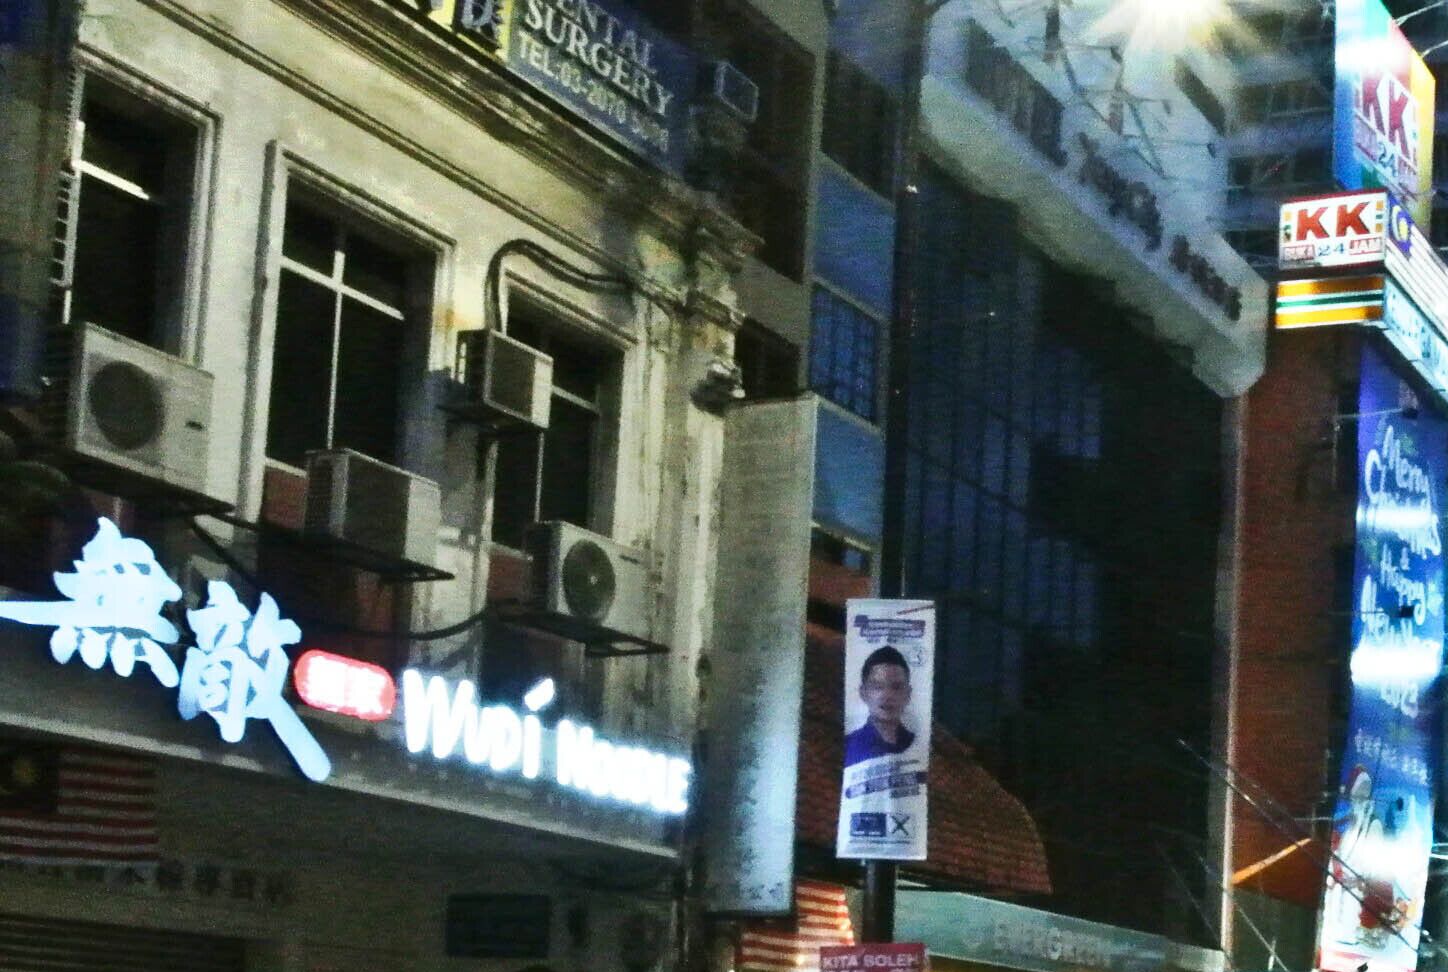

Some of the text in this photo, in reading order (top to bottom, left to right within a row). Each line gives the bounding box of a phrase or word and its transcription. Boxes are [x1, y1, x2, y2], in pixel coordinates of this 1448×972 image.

[525, 0, 675, 117] SURGERY
[1296, 201, 1371, 241] KK
[1317, 242, 1345, 257] 24
[1380, 542, 1427, 626] Happy
[822, 954, 859, 969] KITA
